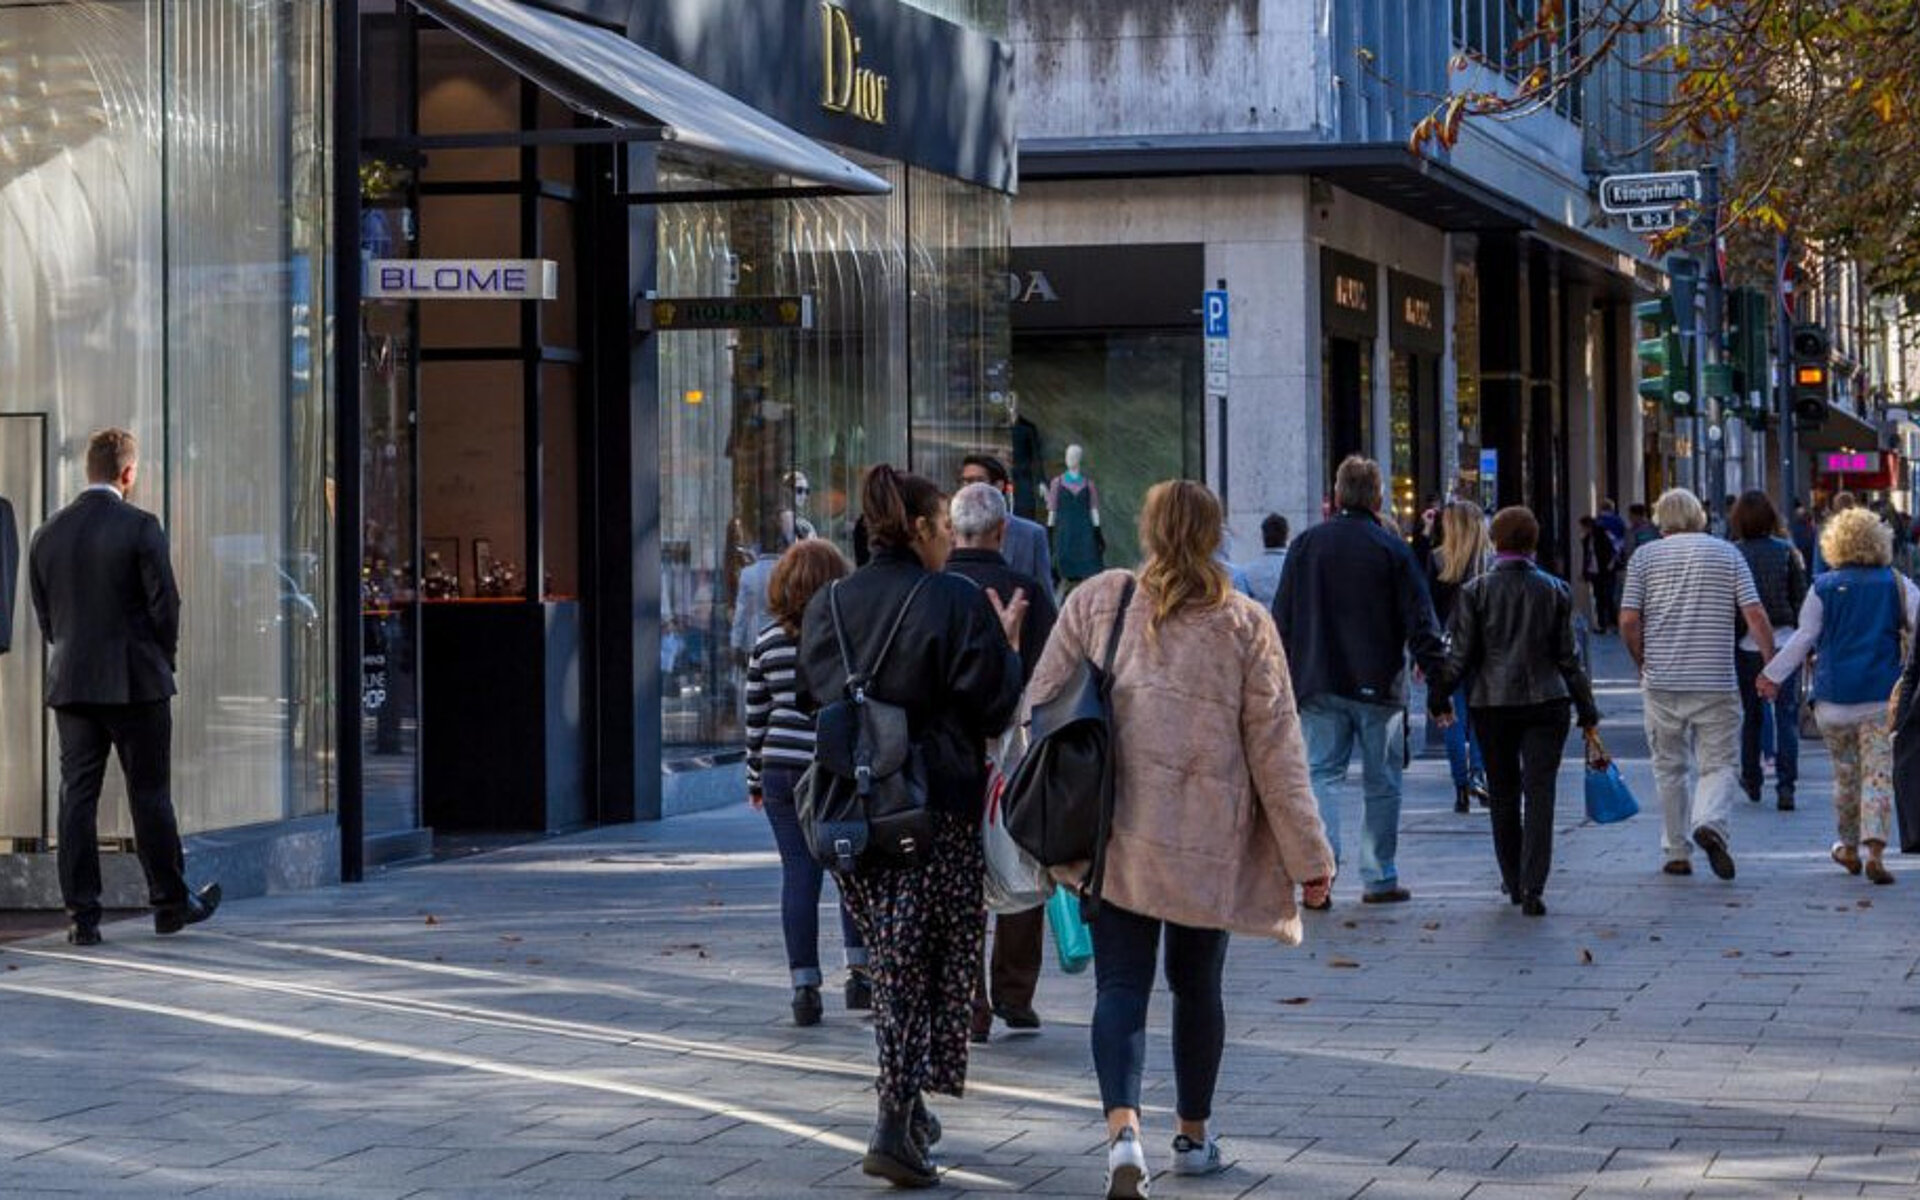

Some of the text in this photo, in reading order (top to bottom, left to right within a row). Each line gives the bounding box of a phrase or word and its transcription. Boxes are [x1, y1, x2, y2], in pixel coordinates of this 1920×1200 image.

[820, 1, 888, 124] Dior
[381, 267, 526, 292] BLOME
[1210, 296, 1224, 333] P
